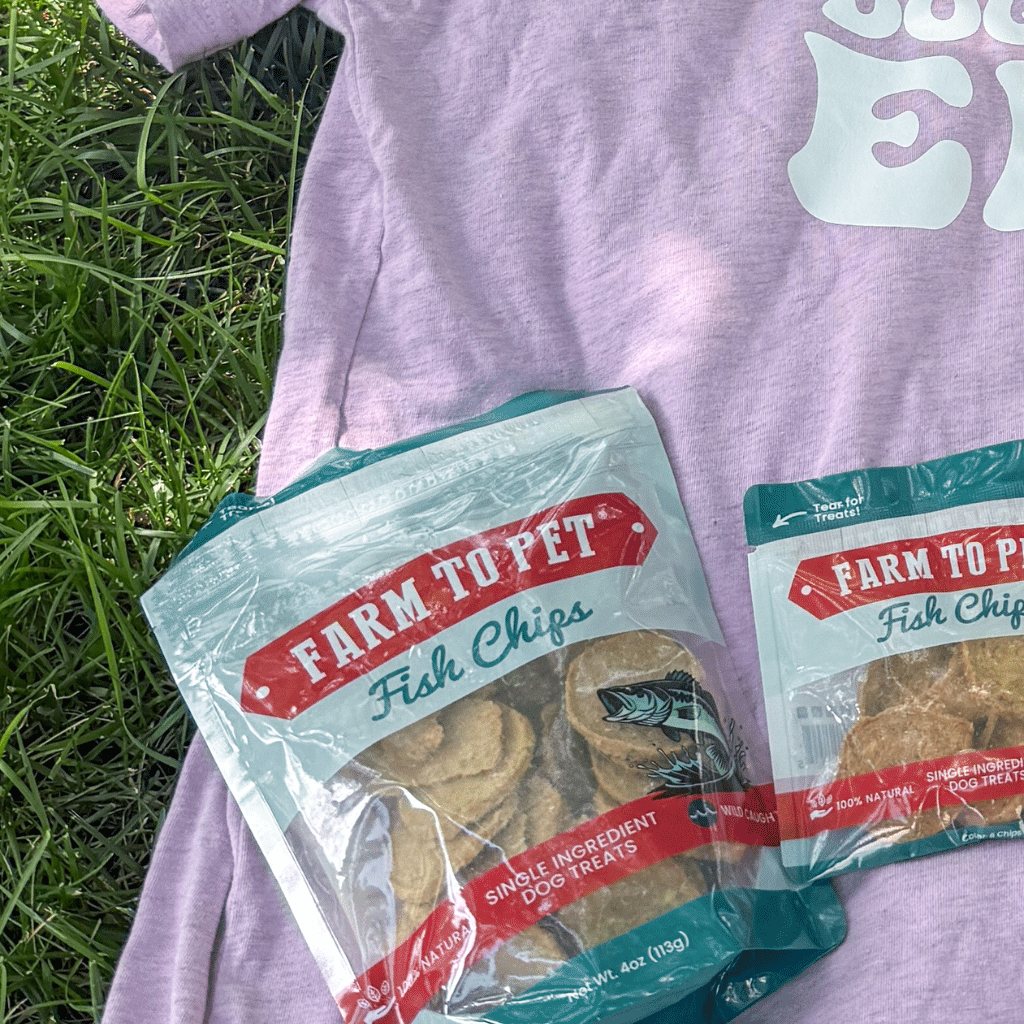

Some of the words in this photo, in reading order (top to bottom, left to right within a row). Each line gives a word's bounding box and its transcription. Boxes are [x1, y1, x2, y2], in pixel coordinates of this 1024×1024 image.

[812, 501, 843, 513] Tear
[845, 496, 865, 508] for
[814, 506, 861, 523] Treats!
[831, 547, 934, 597] FARM
[941, 541, 987, 578] TO
[289, 577, 432, 684] FARM
[431, 547, 501, 602] TO
[505, 513, 597, 573] PET
[876, 595, 947, 643] Fish
[368, 644, 465, 721] Fish
[472, 600, 593, 668] Chips
[835, 795, 863, 811] 100%
[865, 784, 915, 803] NATURAL
[926, 766, 971, 782] SINGLE
[949, 776, 979, 792] DOG
[720, 804, 743, 818] WILD
[485, 860, 550, 905] SINGLE
[551, 811, 658, 869] INGREDIENT
[520, 873, 566, 905] DOG
[568, 839, 638, 879] TREATS
[421, 925, 471, 971] NATURA
[592, 968, 619, 986] Wt.
[619, 955, 647, 974] 4oz
[647, 930, 690, 963] (113g)
